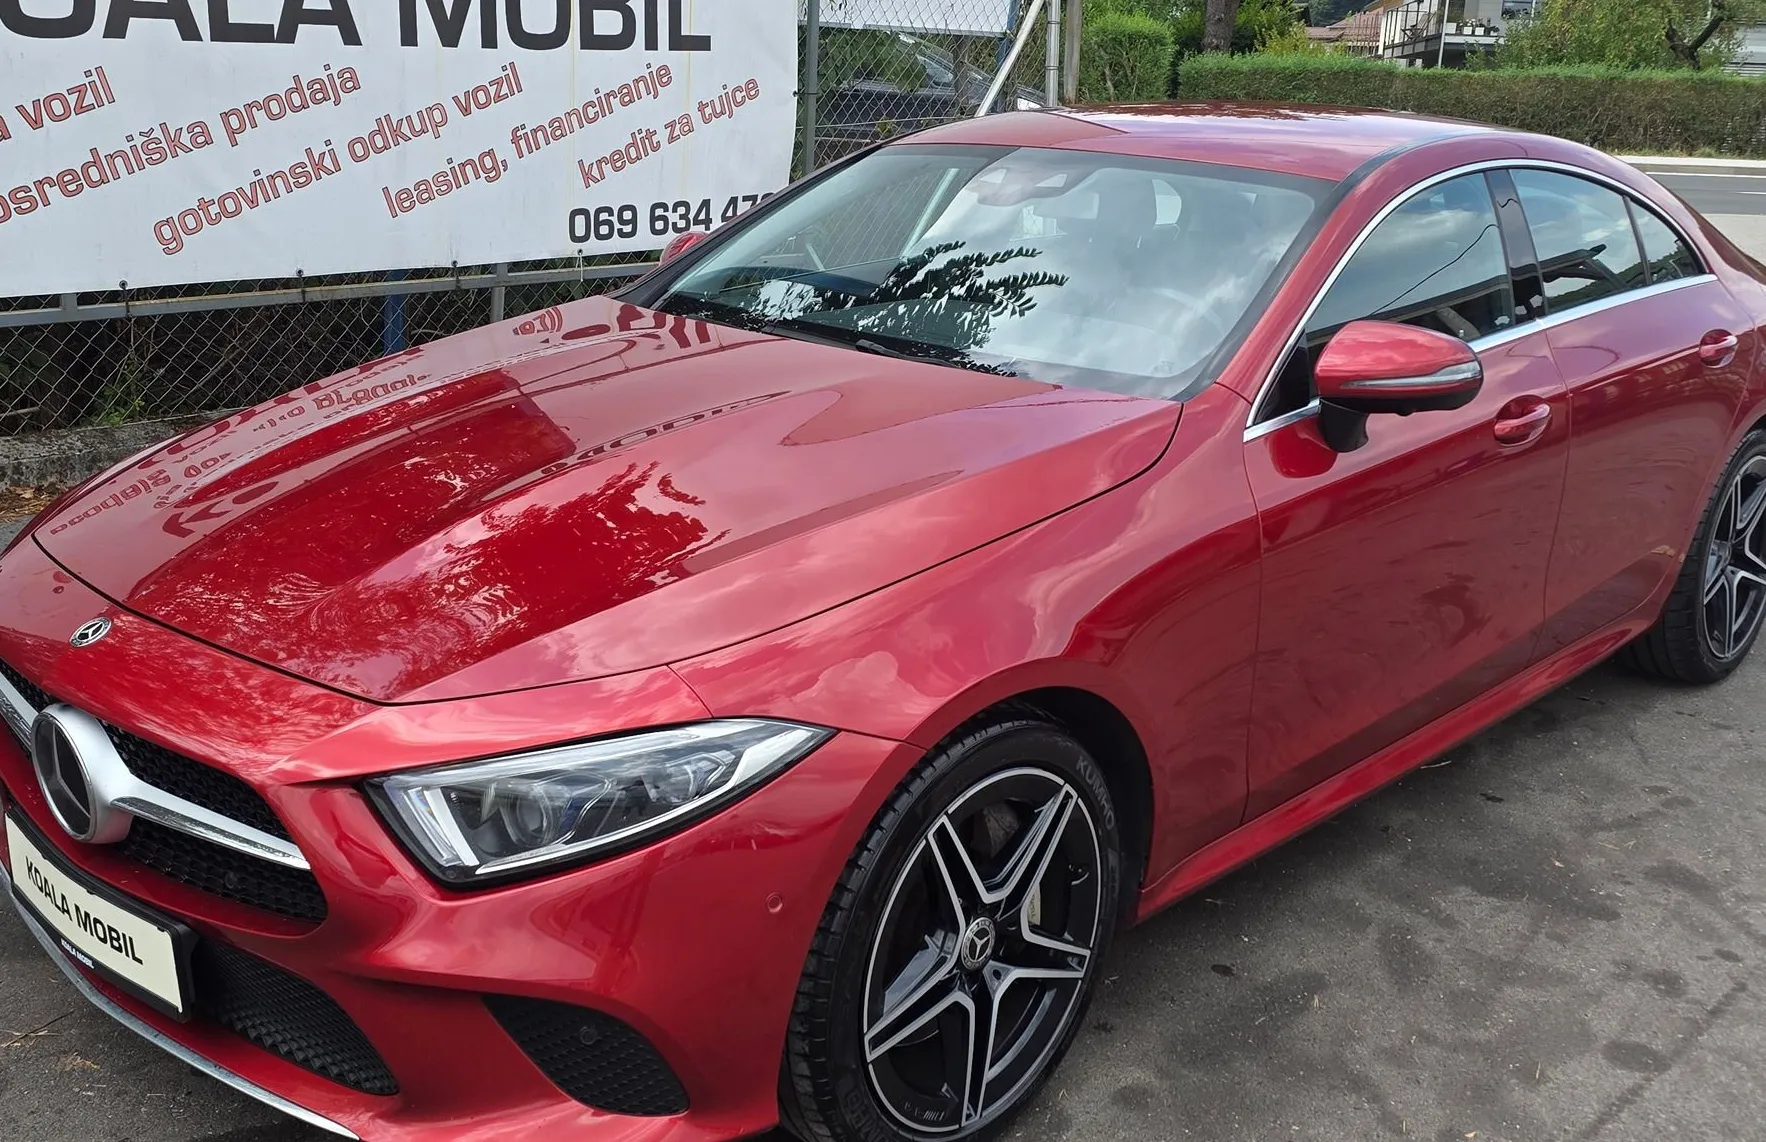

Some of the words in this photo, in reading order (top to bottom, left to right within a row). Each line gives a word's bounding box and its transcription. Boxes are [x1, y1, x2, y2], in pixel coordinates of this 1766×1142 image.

[15, 65, 116, 130] vozil
[219, 63, 362, 147] prodaja
[382, 147, 508, 219] leasing,
[510, 62, 673, 159] financiranje
[577, 128, 661, 189] kredit
[664, 111, 694, 145] za
[697, 76, 761, 127] tujce
[153, 139, 342, 256] gotovinski
[347, 102, 448, 164] odkup
[452, 62, 524, 118] vozil
[568, 203, 638, 243] 069
[649, 198, 713, 236] 634
[720, 192, 775, 223] 47
[1076, 755, 1115, 830] KUMHO
[25, 855, 73, 922] KOALA
[74, 903, 144, 966] MOBIL
